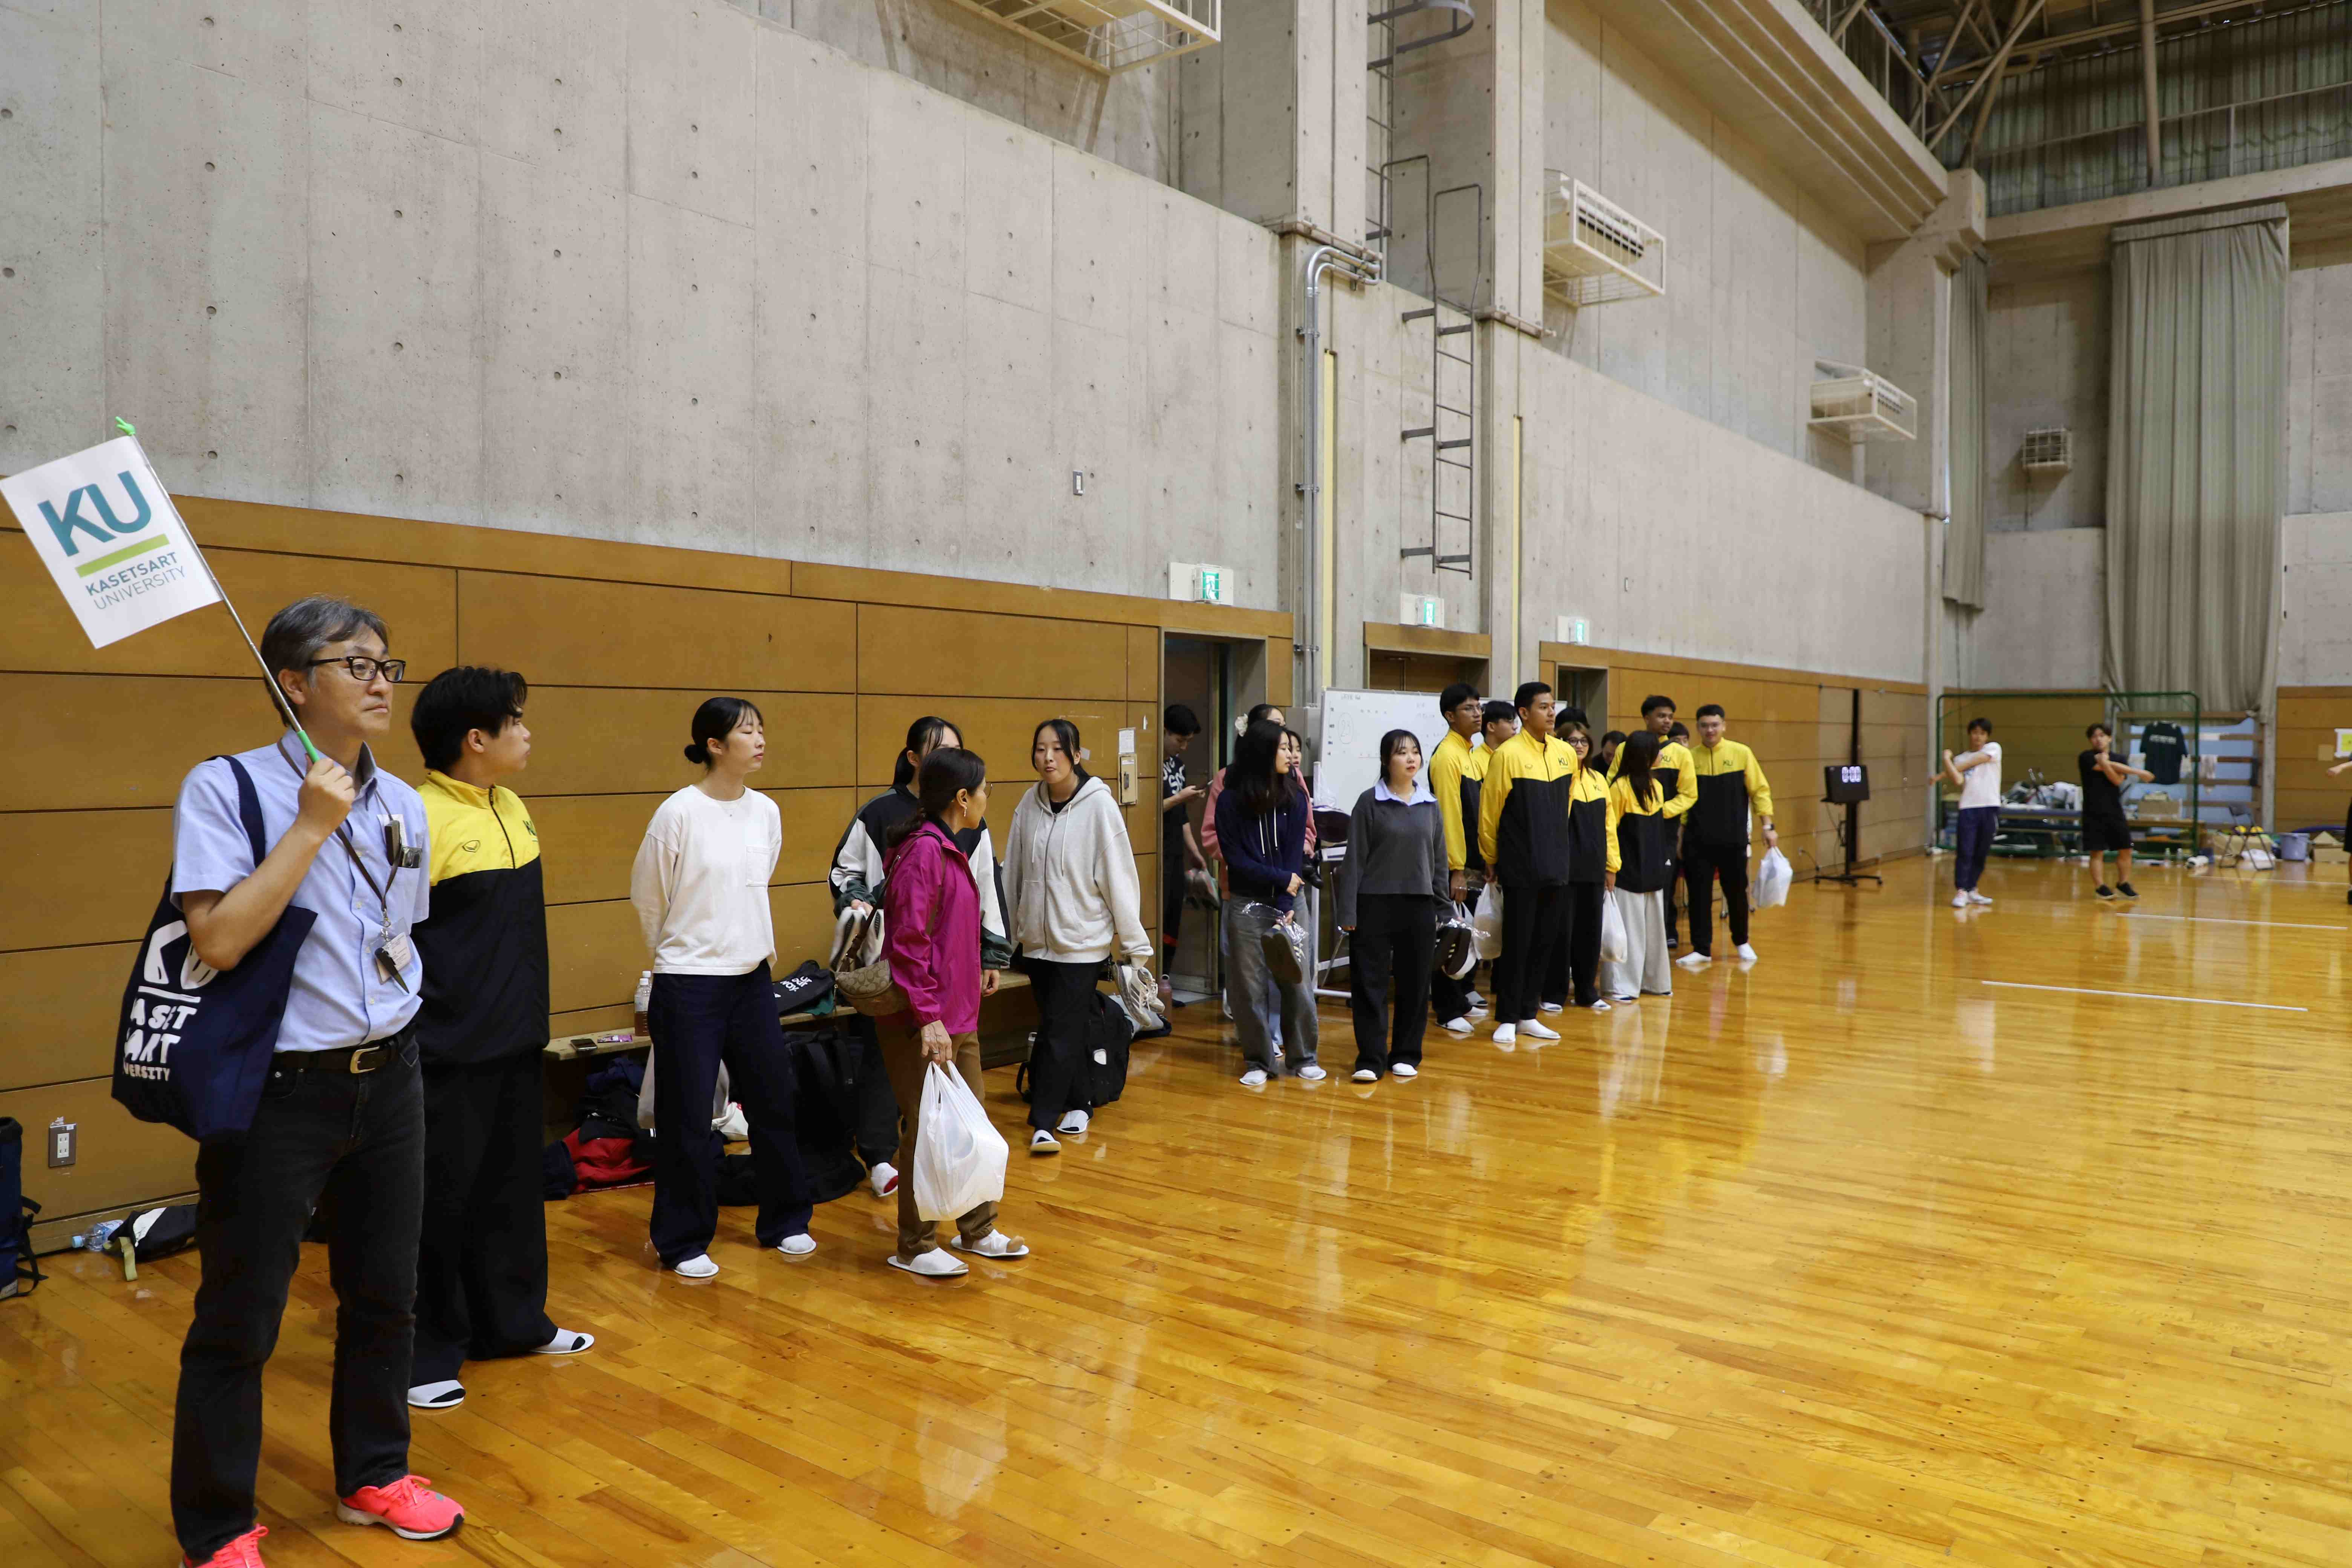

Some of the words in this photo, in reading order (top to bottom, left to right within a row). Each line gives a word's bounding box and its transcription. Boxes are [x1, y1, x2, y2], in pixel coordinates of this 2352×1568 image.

[38, 470, 151, 557] KU
[86, 552, 177, 596] KASETSART
[94, 566, 185, 609] UNIVERSITY
[1558, 757, 1568, 766] KU
[122, 1060, 171, 1081] VERSITY
